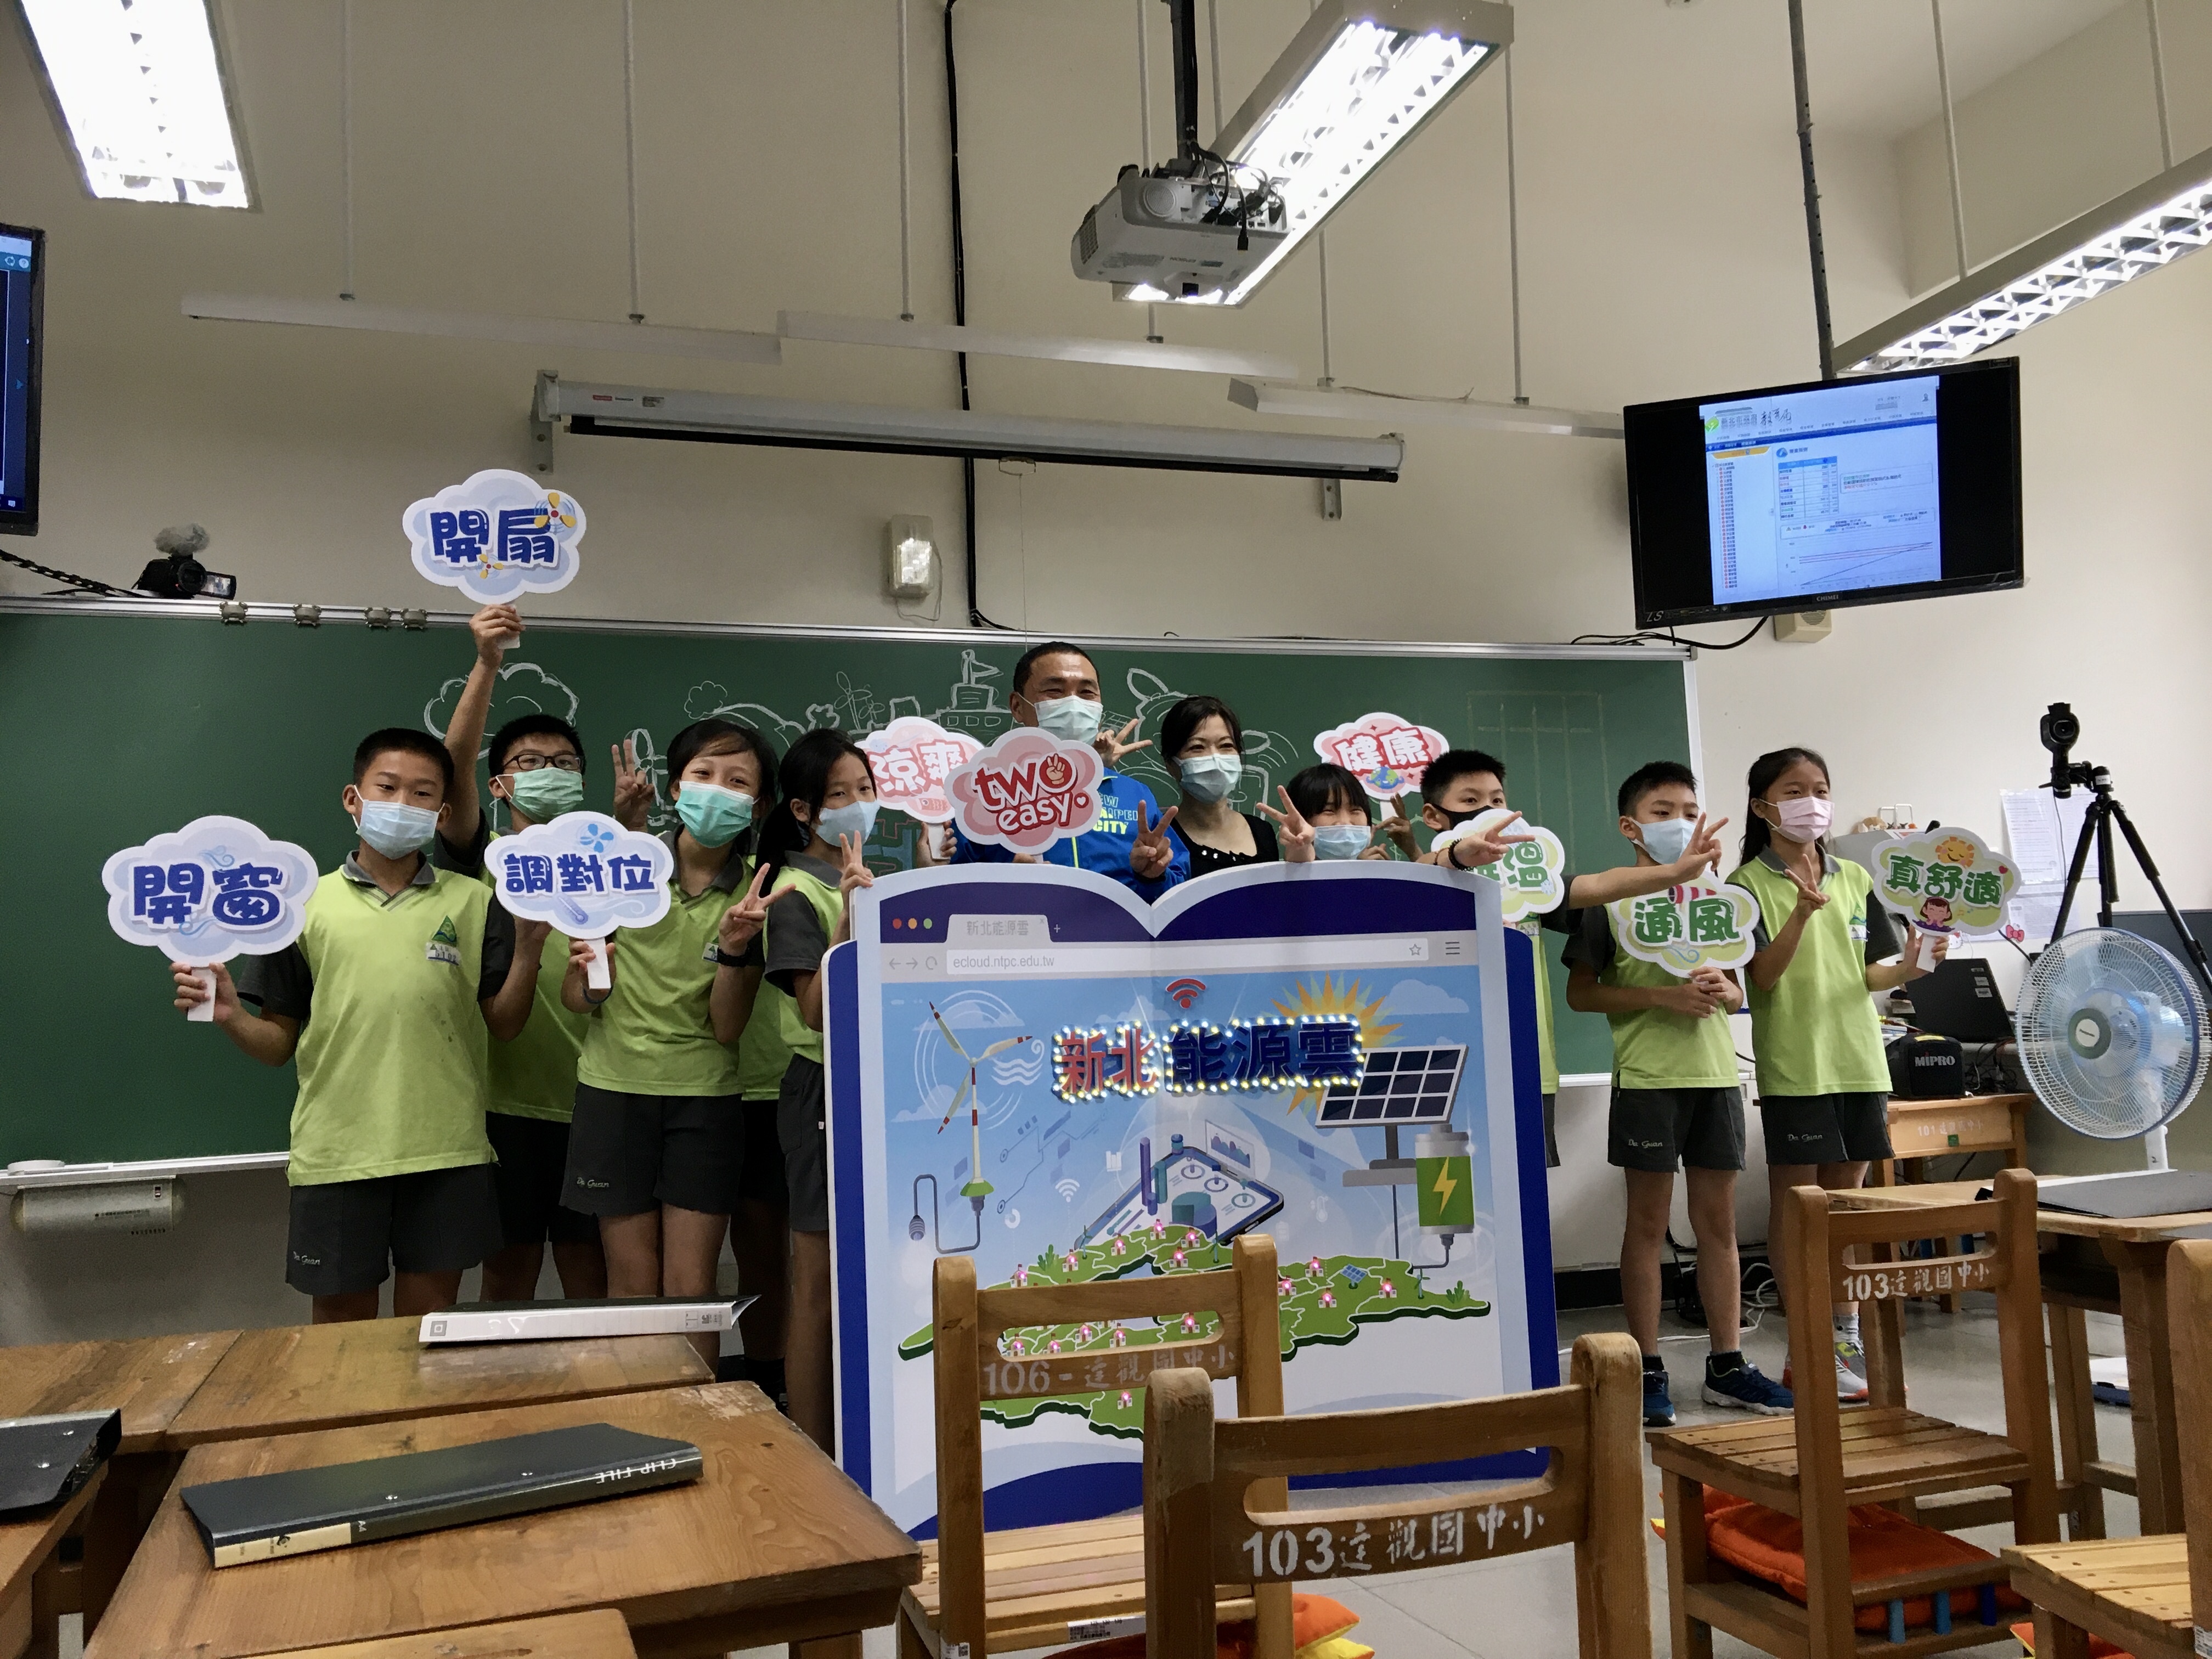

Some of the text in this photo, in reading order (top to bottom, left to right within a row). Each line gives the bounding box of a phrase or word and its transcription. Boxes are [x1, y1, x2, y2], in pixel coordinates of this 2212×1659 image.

[430, 508, 555, 563] 開扇
[869, 739, 966, 794] 涼爽
[1335, 727, 1431, 773] 健康
[975, 753, 1077, 813] two
[996, 792, 1073, 834] easy
[1092, 820, 1129, 834] CITY
[1099, 808, 1138, 821] AIPEI
[504, 853, 655, 893] 調對位
[1475, 842, 1548, 888] 溫
[1886, 854, 2005, 906] 真舒適
[133, 862, 284, 926] 開窗
[966, 920, 1029, 936] 新北能源雲
[1634, 896, 1740, 944] 通風
[953, 955, 1055, 969] ecloud.ntpc.edu.tw
[1060, 1022, 1359, 1093] 新北能源雲
[1641, 1141, 1663, 1149] Guan
[1787, 1133, 1823, 1143] Da Guan
[587, 1179, 610, 1189] Guan
[301, 1255, 320, 1266] Guan
[595, 1458, 676, 1484] CLIP FILE
[358, 1520, 367, 1532] A4
